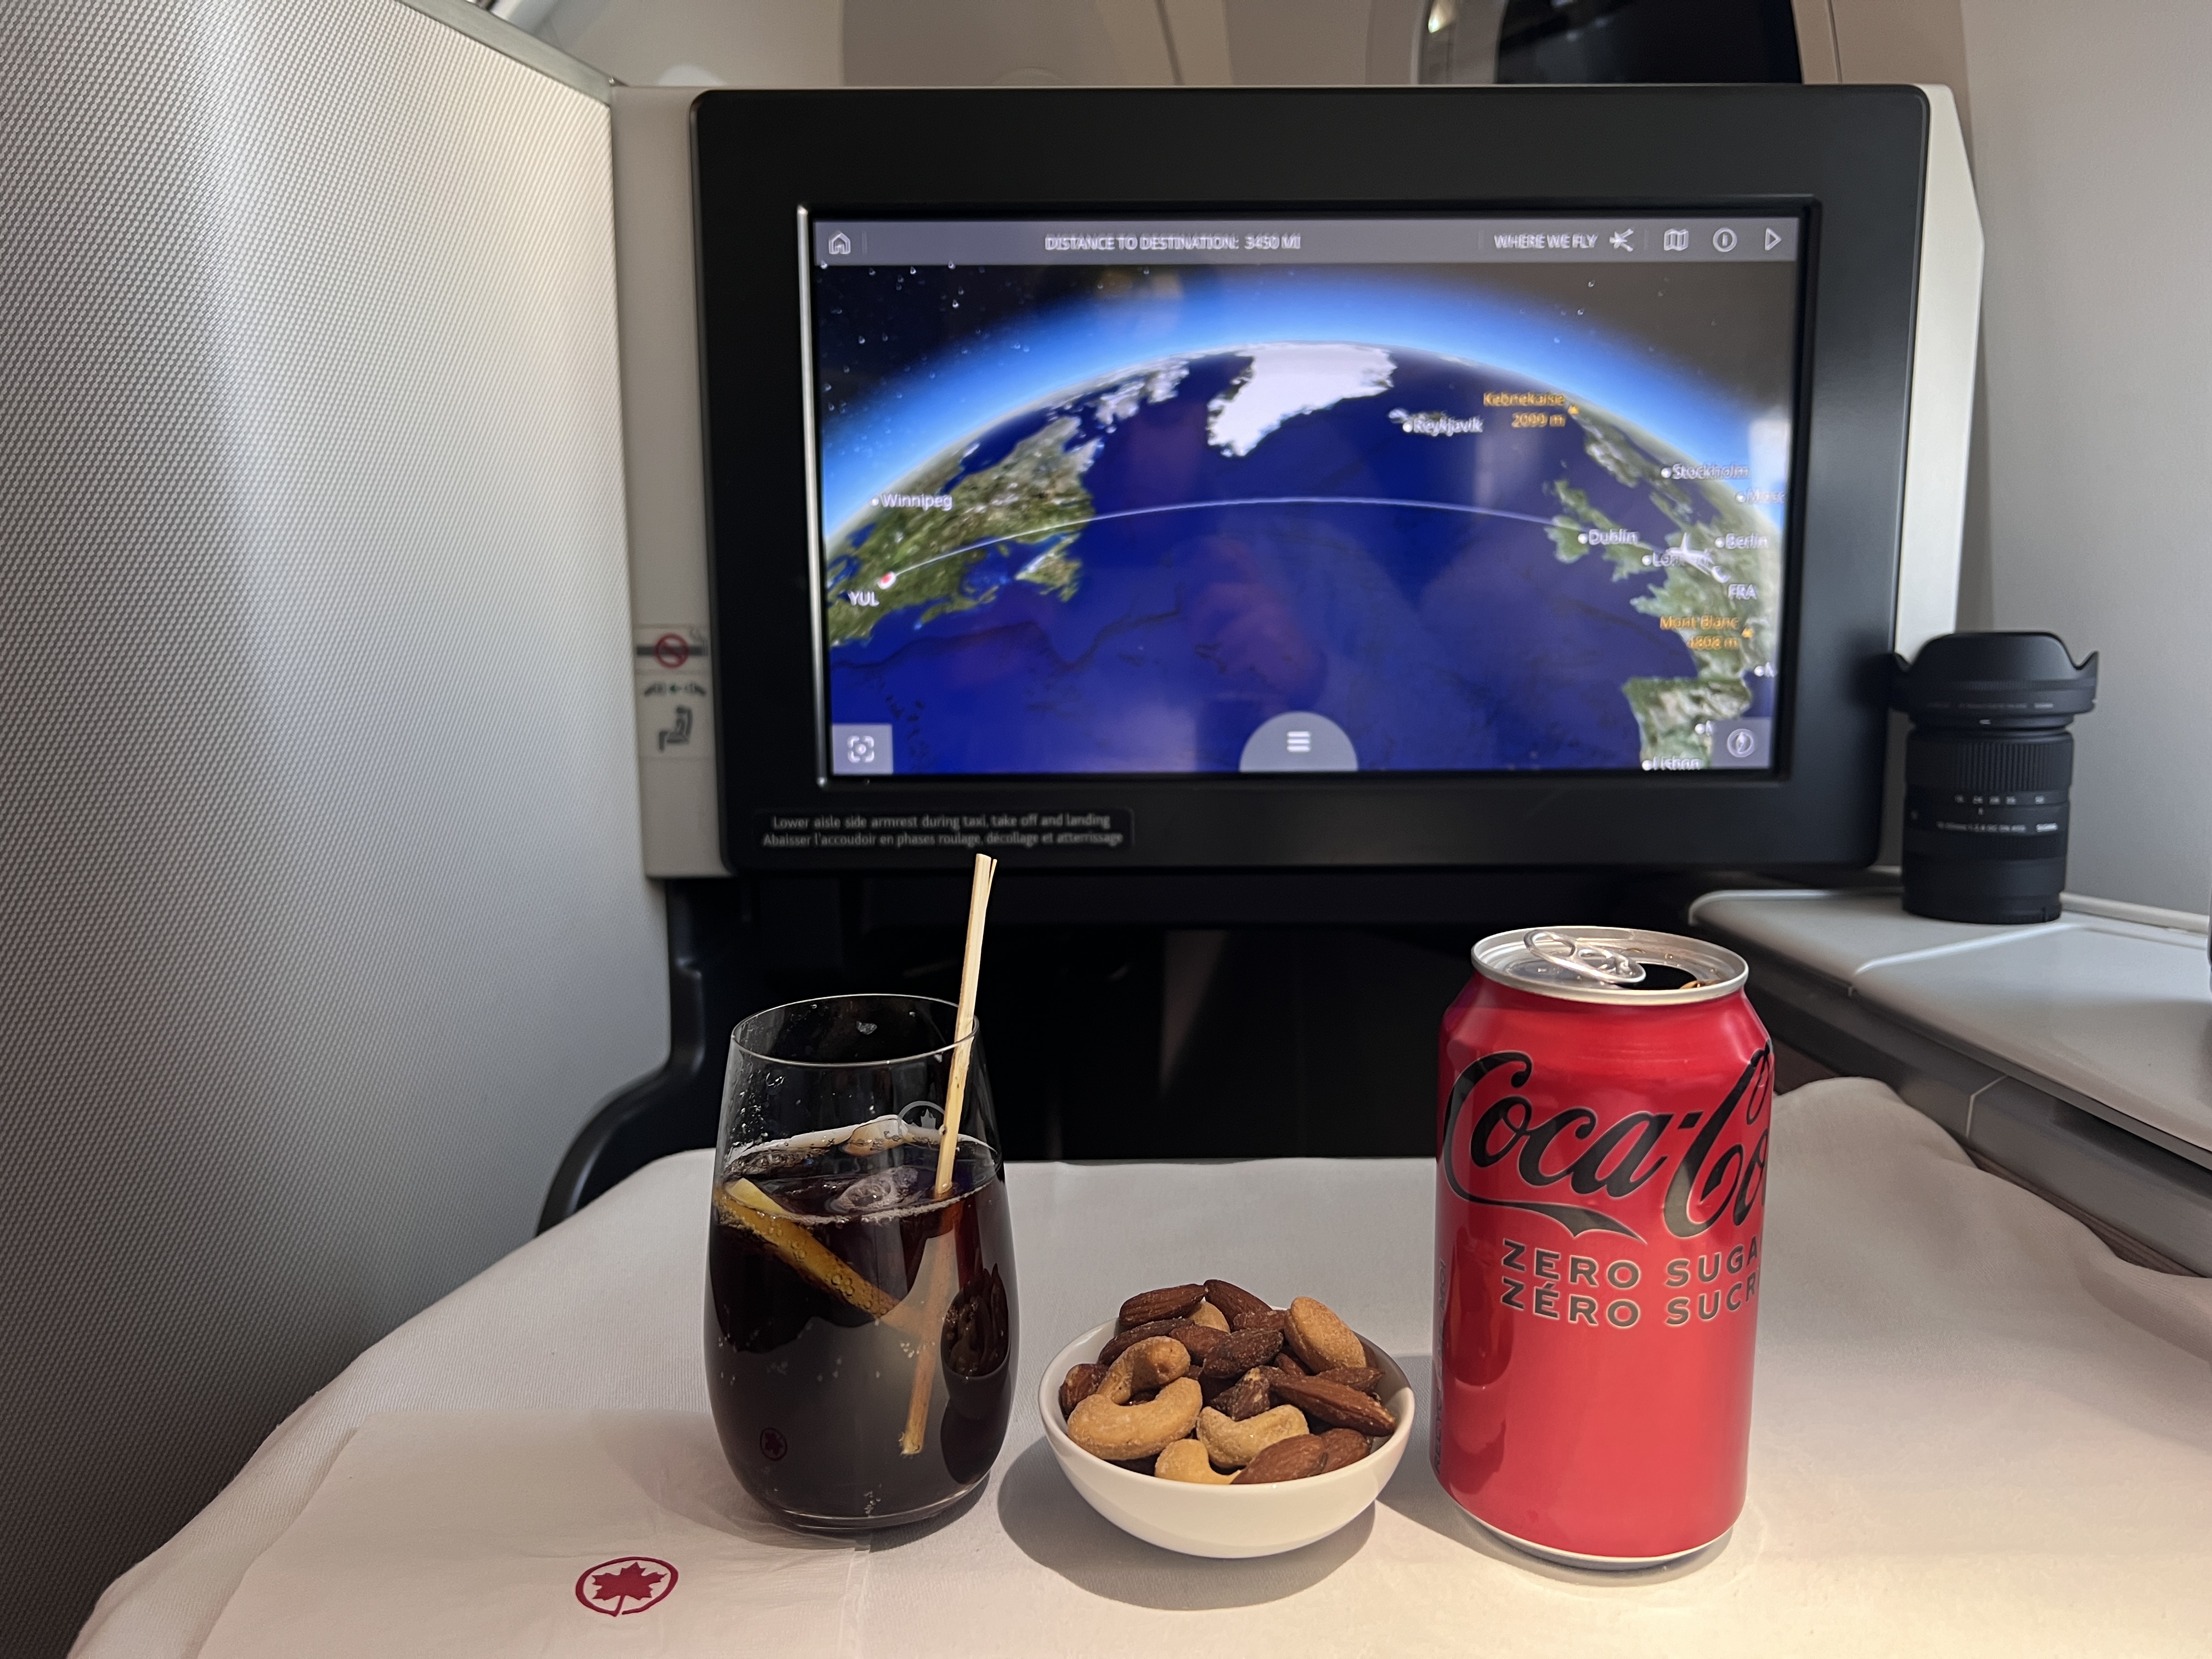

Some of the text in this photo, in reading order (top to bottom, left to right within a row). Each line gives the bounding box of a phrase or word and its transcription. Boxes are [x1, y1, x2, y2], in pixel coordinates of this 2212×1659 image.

[1045, 235, 1115, 250] DISTANCE
[1117, 235, 1137, 250] TO
[1139, 235, 1239, 250] DESTINATION:
[1494, 234, 1599, 249] WHERE WE FLY
[1413, 416, 1483, 437] Reykjavik
[1672, 462, 1750, 479] Stockholm
[879, 494, 953, 511] Winnipeg
[1589, 528, 1639, 545] Dublin
[1725, 532, 1769, 549] Berlin
[848, 591, 879, 607] YUL
[1728, 584, 1757, 600] FRA
[1660, 615, 1739, 630] Mont Blanc
[774, 816, 809, 829] Lower
[814, 815, 841, 829] aisle
[845, 815, 867, 828] side
[871, 816, 917, 828] armrest
[922, 814, 960, 830] during
[991, 815, 1017, 827] take
[1021, 813, 1039, 827] off
[1041, 814, 1063, 826] and
[1066, 813, 1110, 829] landing
[764, 833, 811, 847] Abaisser
[815, 832, 877, 846] l'accoudoir
[880, 834, 894, 845] en
[898, 832, 935, 848] phases
[986, 831, 1040, 847] décollage
[1042, 832, 1053, 843] et
[1057, 832, 1123, 847] atterrissage
[1502, 1234, 1758, 1289] ZERO SUGA
[1502, 1271, 1757, 1329] ZÉRO SUCR
